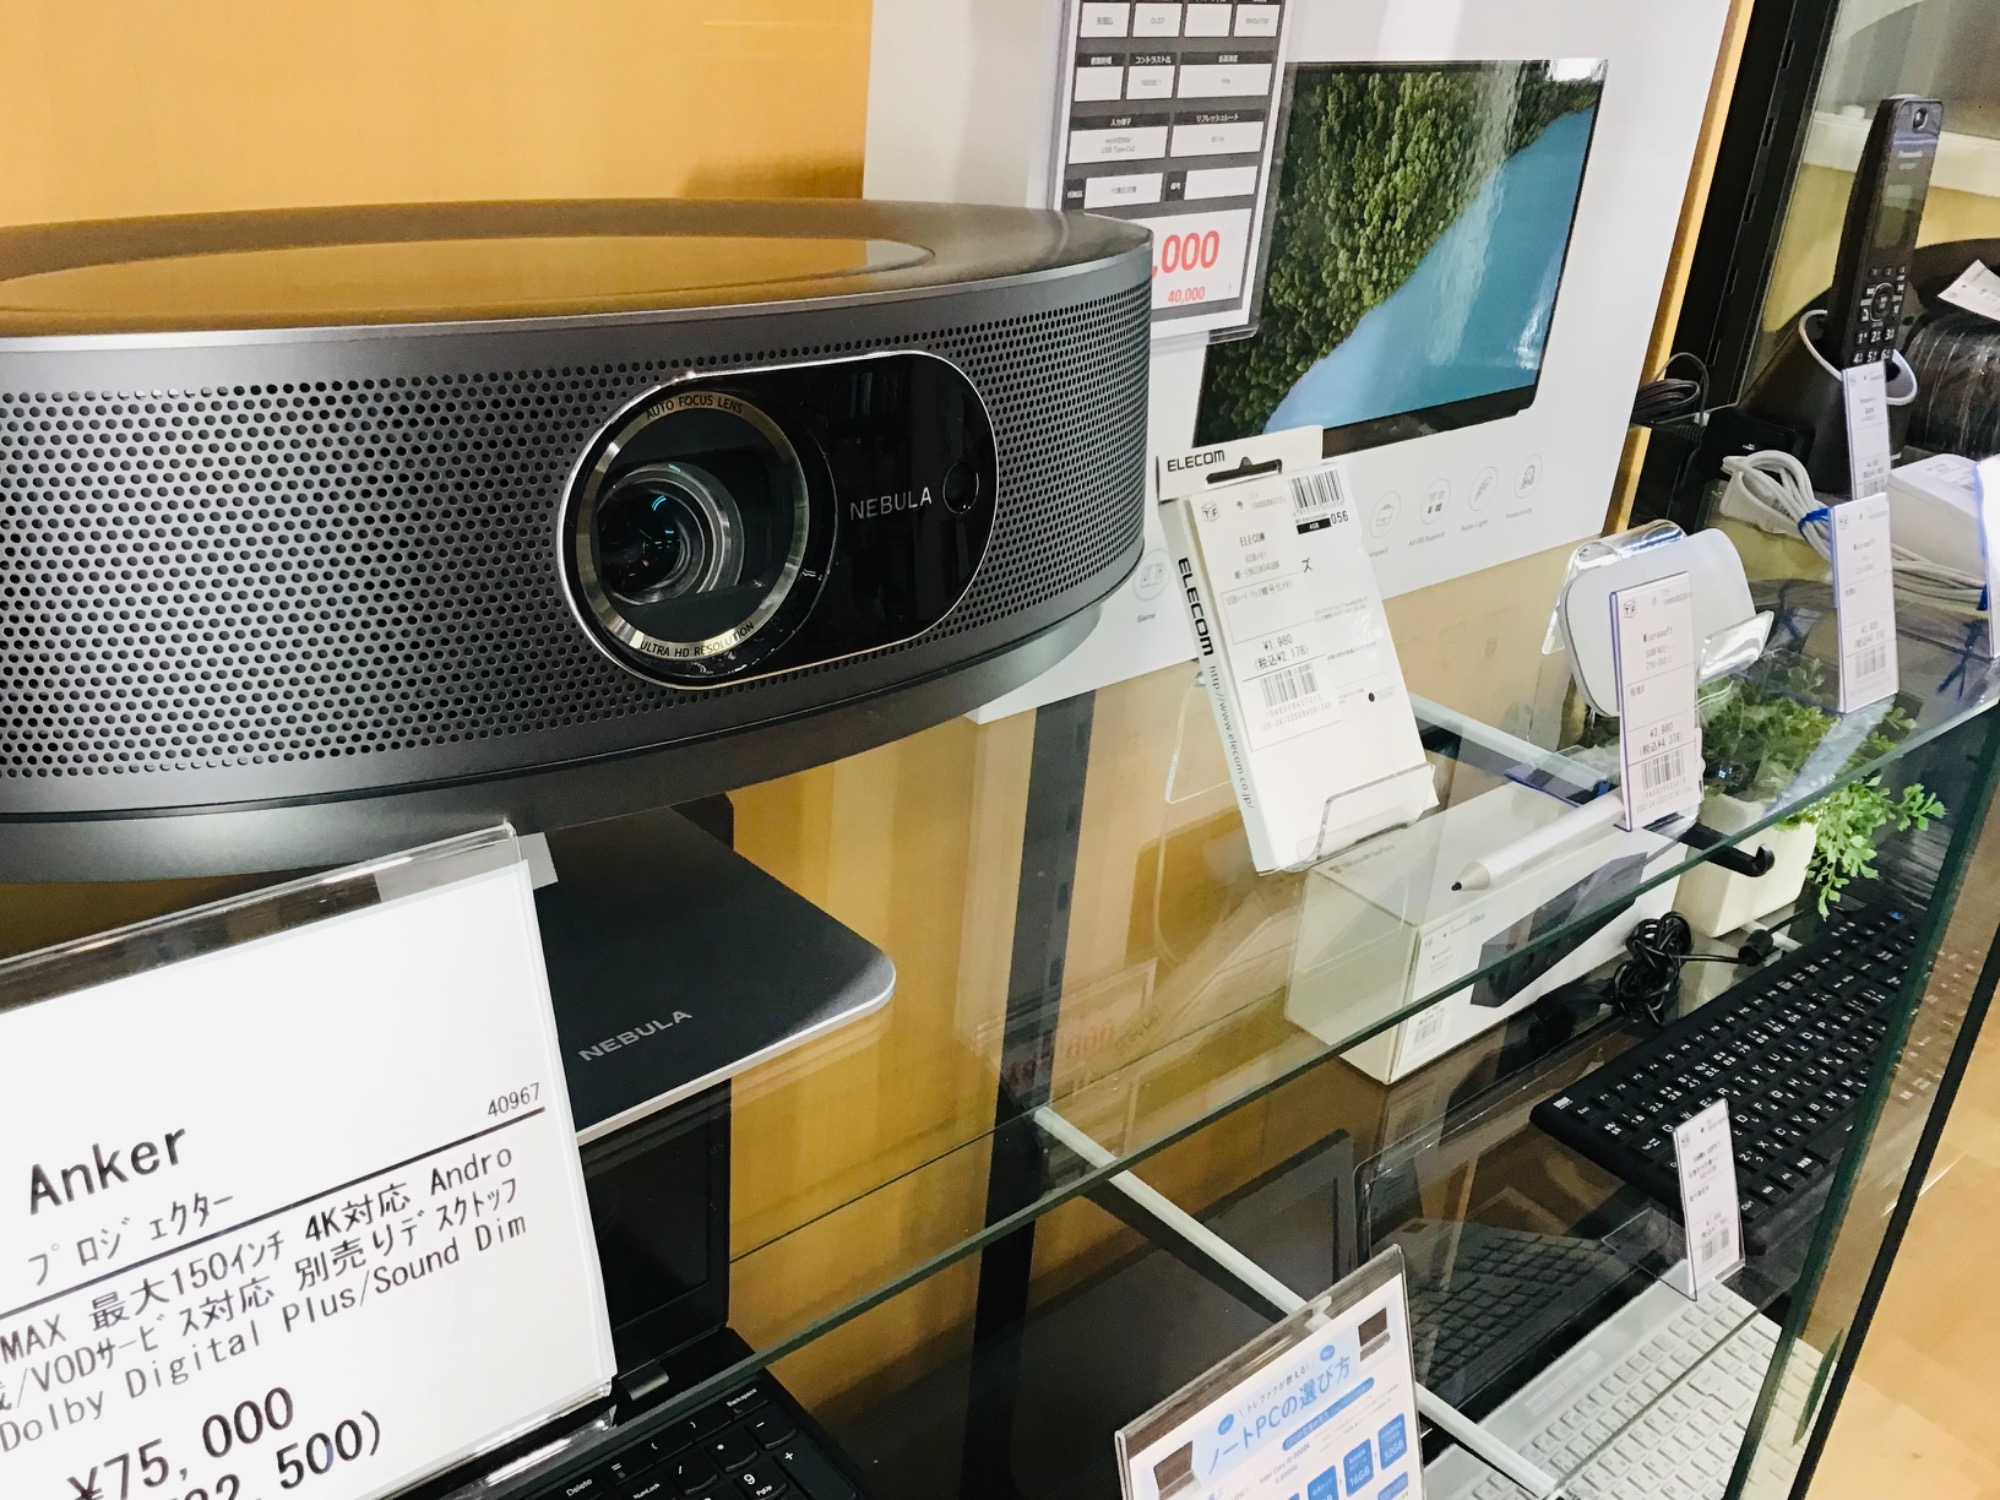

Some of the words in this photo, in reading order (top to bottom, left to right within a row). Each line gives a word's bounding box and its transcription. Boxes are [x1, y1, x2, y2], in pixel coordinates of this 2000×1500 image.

[1168, 286, 1206, 304] 40,000
[646, 400, 674, 420] AUTO
[678, 395, 713, 406] FOCUS
[718, 398, 743, 414] LENS
[1167, 449, 1225, 472] ELECOM
[850, 486, 933, 521] NEBULA
[1330, 510, 1349, 524] 056
[1239, 532, 1266, 547] ELECOM
[1178, 557, 1214, 656] ELECOM
[640, 640, 670, 657] ULTRA
[674, 648, 690, 657] HD
[694, 621, 755, 656] RESOLUTION
[1210, 665, 1255, 810] http://www.elecom.co.jp/
[578, 1010, 693, 1061] NEBULA
[486, 1082, 541, 1118] 40967
[29, 1128, 187, 1215] Anker
[0, 1314, 67, 1364] MAX
[304, 1182, 411, 1242] 4K対応
[430, 1148, 513, 1196] Andro
[0, 1391, 103, 1451] Dolby
[125, 1320, 260, 1399] Digital
[282, 1237, 460, 1333] Plus/Sound
[475, 1215, 527, 1252] Dim
[1208, 1355, 1350, 1475] ノートPCの選び方
[566, 1478, 593, 1497] Delete
[743, 1473, 756, 1485] 9
